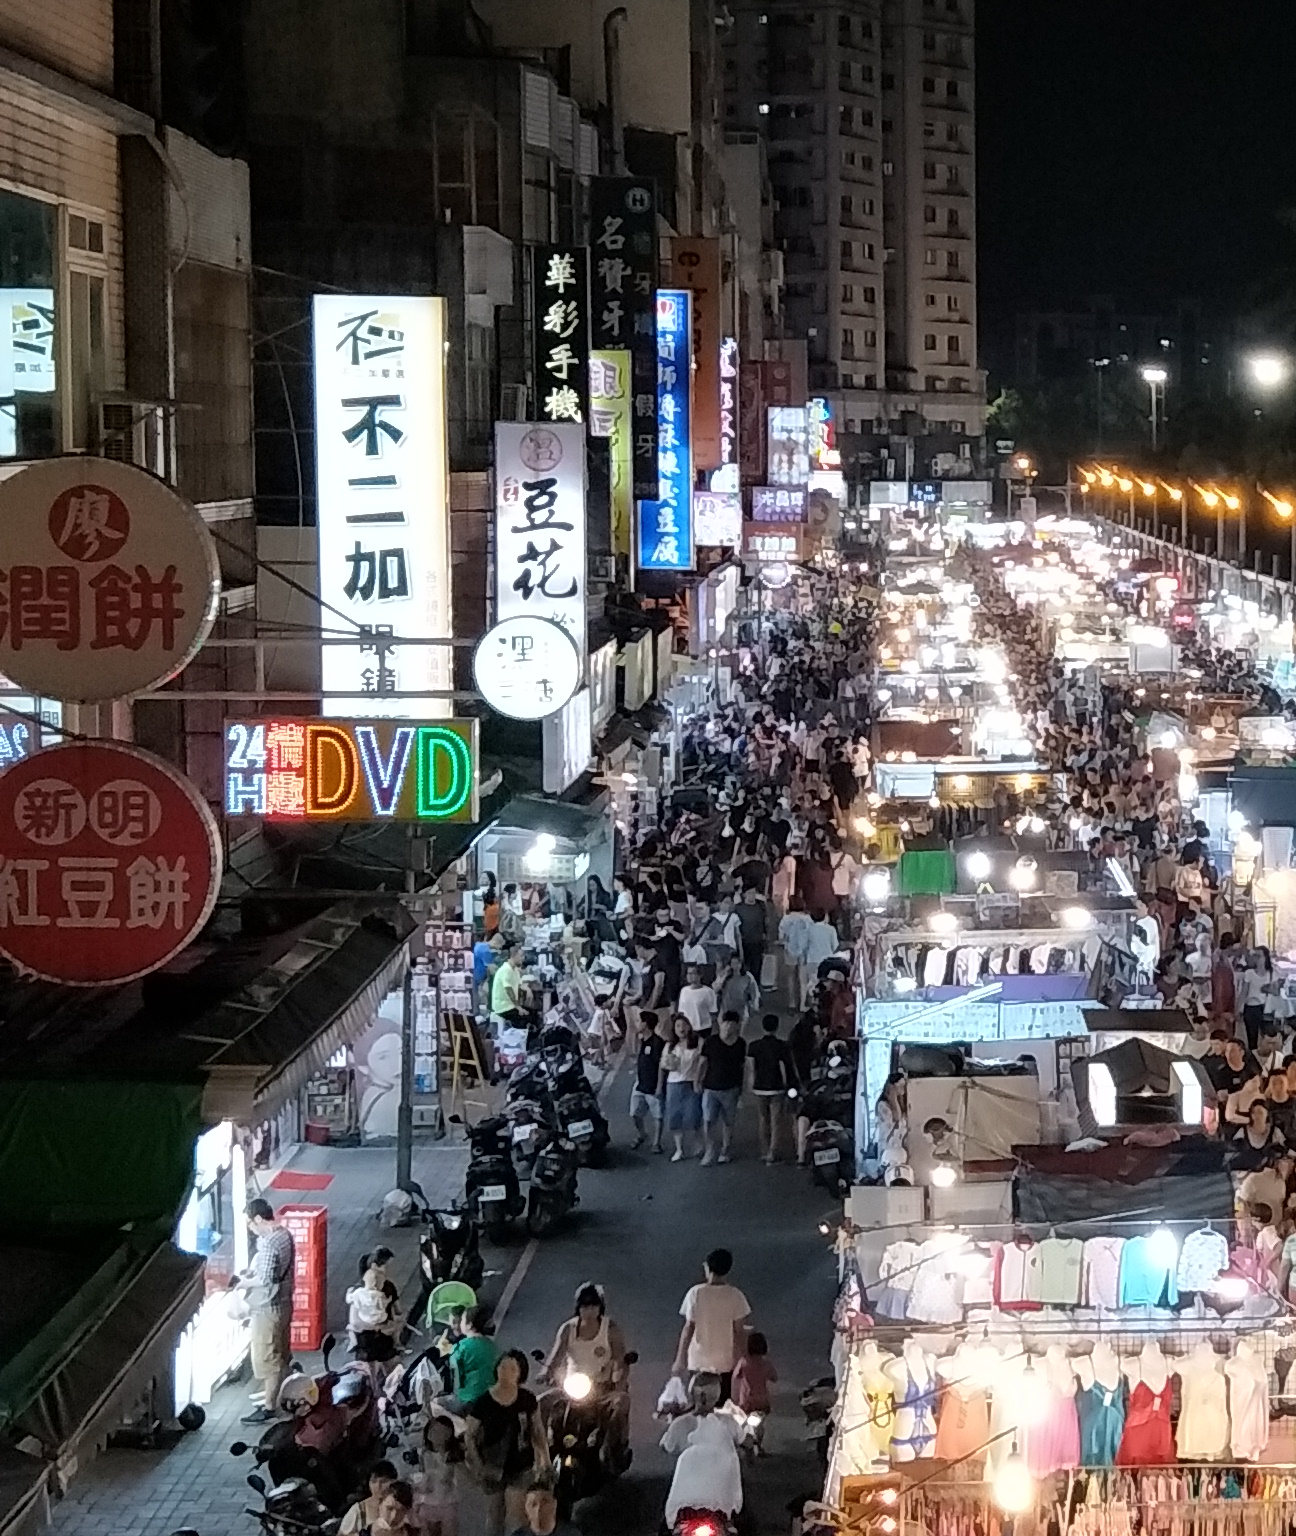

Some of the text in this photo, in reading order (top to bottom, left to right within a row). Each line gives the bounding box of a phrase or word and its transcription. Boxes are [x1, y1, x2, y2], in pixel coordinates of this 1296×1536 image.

[544, 252, 582, 423] 華彩手機
[58, 491, 126, 561] 廖
[342, 394, 409, 602] 不二加
[511, 476, 578, 602] 豆花
[0, 564, 185, 652] 潤餅
[227, 723, 267, 768] 24
[306, 725, 473, 817] DVD
[22, 787, 149, 839] 新明
[227, 772, 267, 814] H
[0, 855, 191, 930] 紅豆餅
